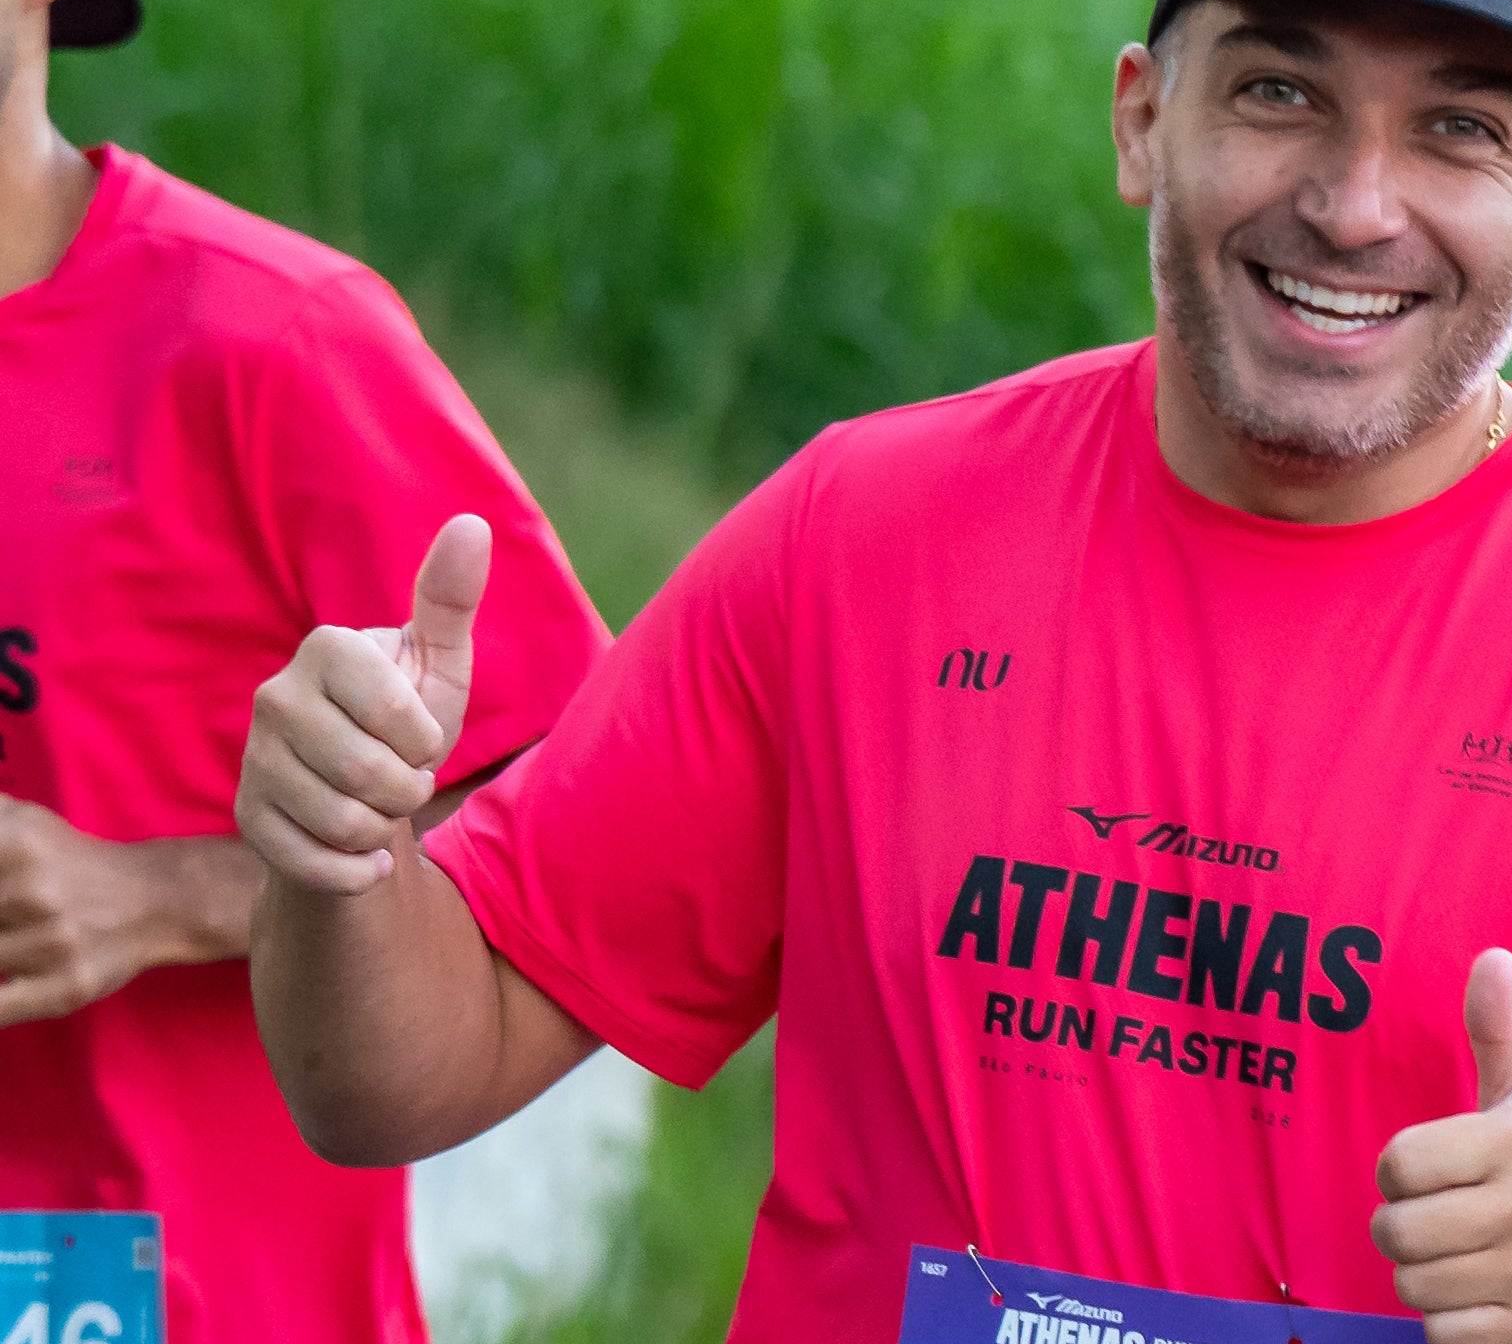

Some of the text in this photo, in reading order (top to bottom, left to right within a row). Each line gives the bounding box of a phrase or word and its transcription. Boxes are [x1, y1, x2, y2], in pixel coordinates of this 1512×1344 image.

[936, 854, 1383, 1034] ATHENAS
[982, 991, 1299, 1094] RUN FASTER
